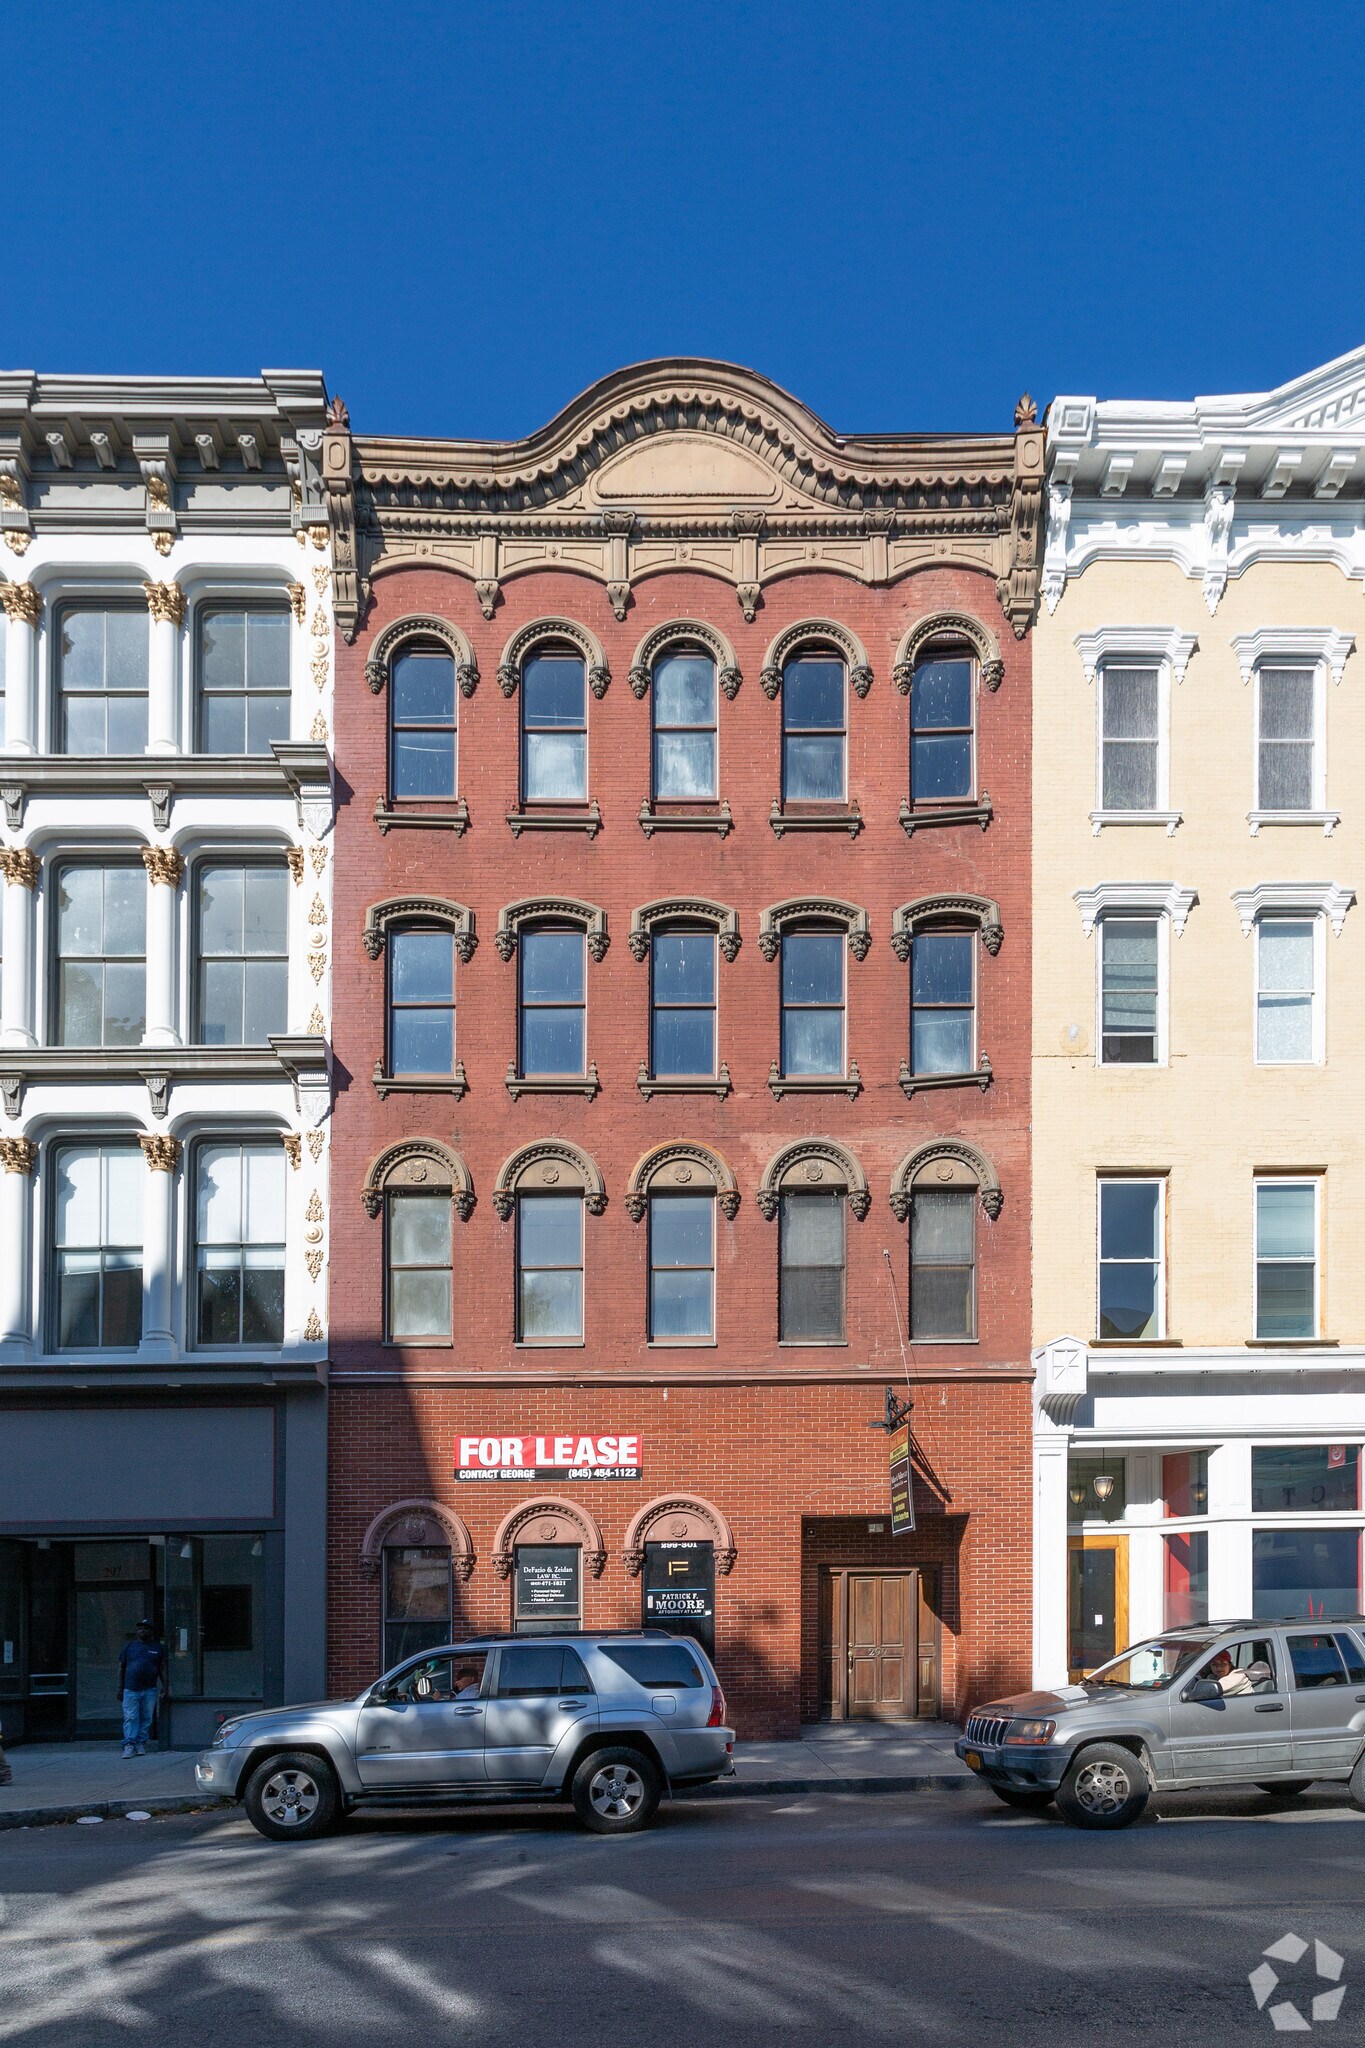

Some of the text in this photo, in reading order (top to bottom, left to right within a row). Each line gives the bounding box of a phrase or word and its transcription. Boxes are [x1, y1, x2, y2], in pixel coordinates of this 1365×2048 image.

[459, 1436, 638, 1466] FOR LEASE
[459, 1468, 637, 1479] CONTACT GEORGE (845) 454-1122
[655, 1599, 705, 1610] MOORE
